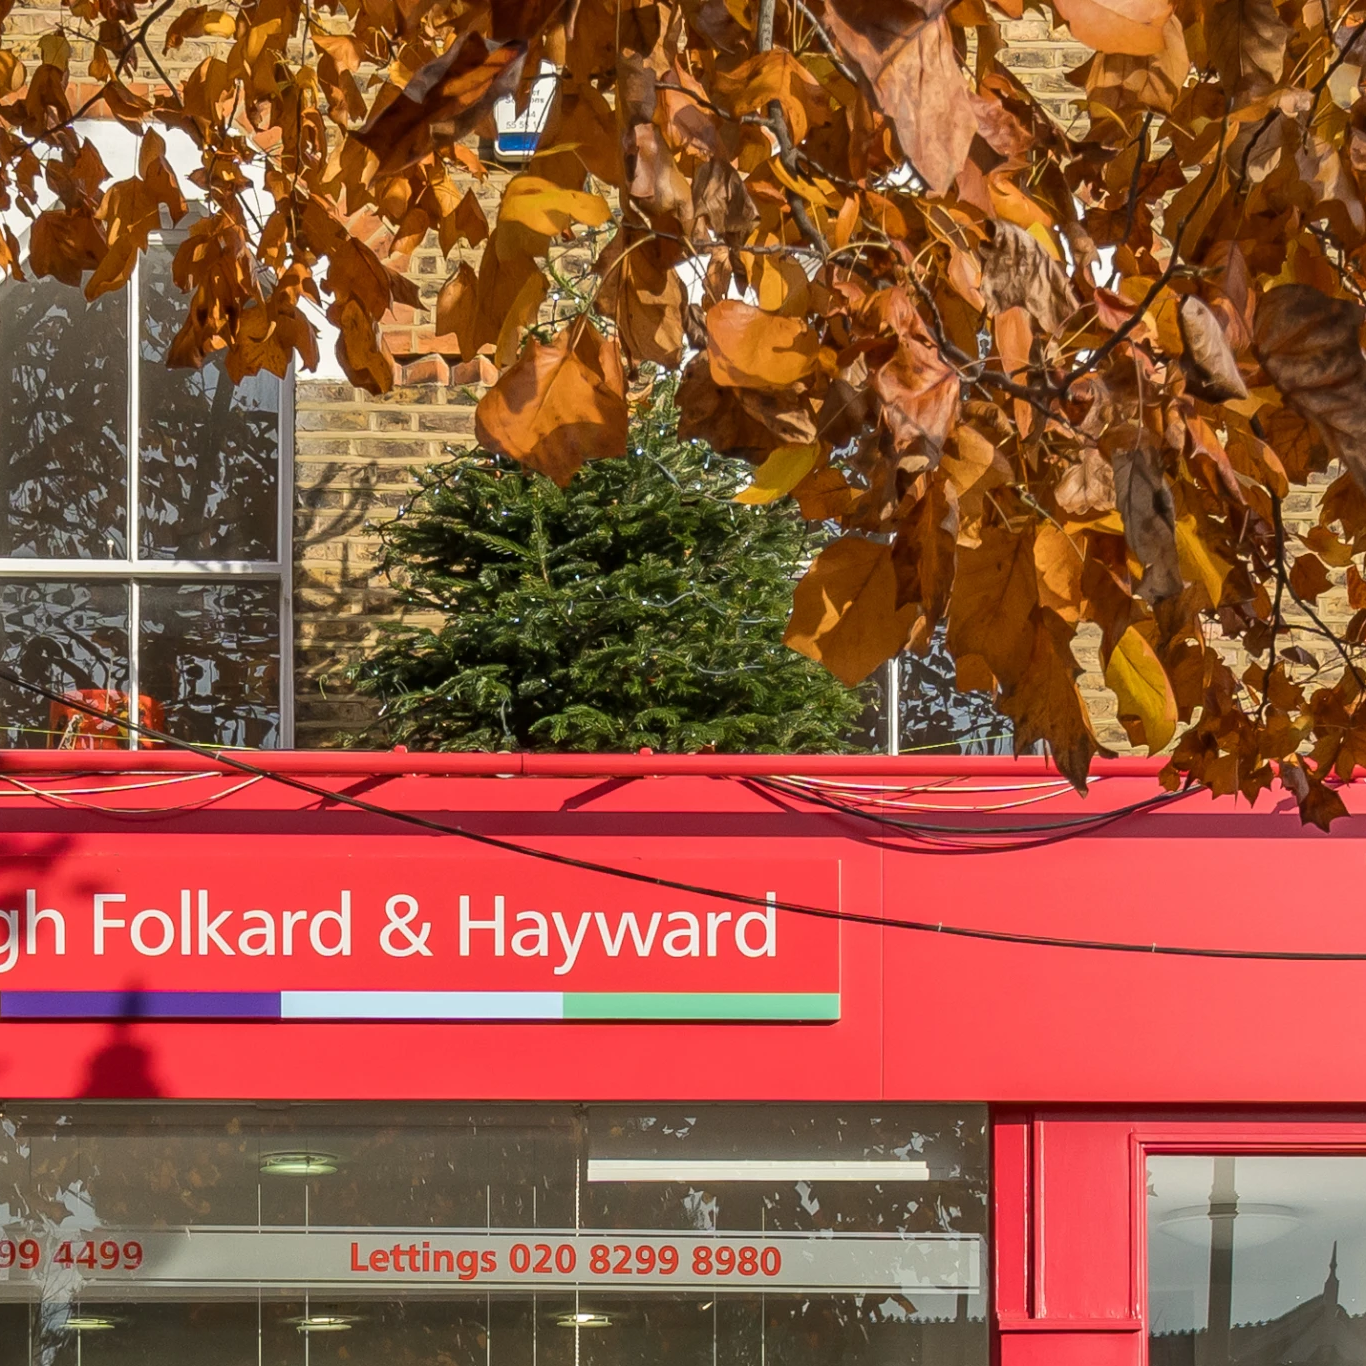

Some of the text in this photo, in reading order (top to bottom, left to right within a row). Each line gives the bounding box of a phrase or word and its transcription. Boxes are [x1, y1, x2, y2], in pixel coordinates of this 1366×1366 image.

[94, 890, 352, 957] Folkard
[378, 893, 434, 958] &
[458, 892, 778, 975] Hayward
[53, 1240, 144, 1271] 4499
[350, 1242, 783, 1281] Lettings 020 8299 8980
